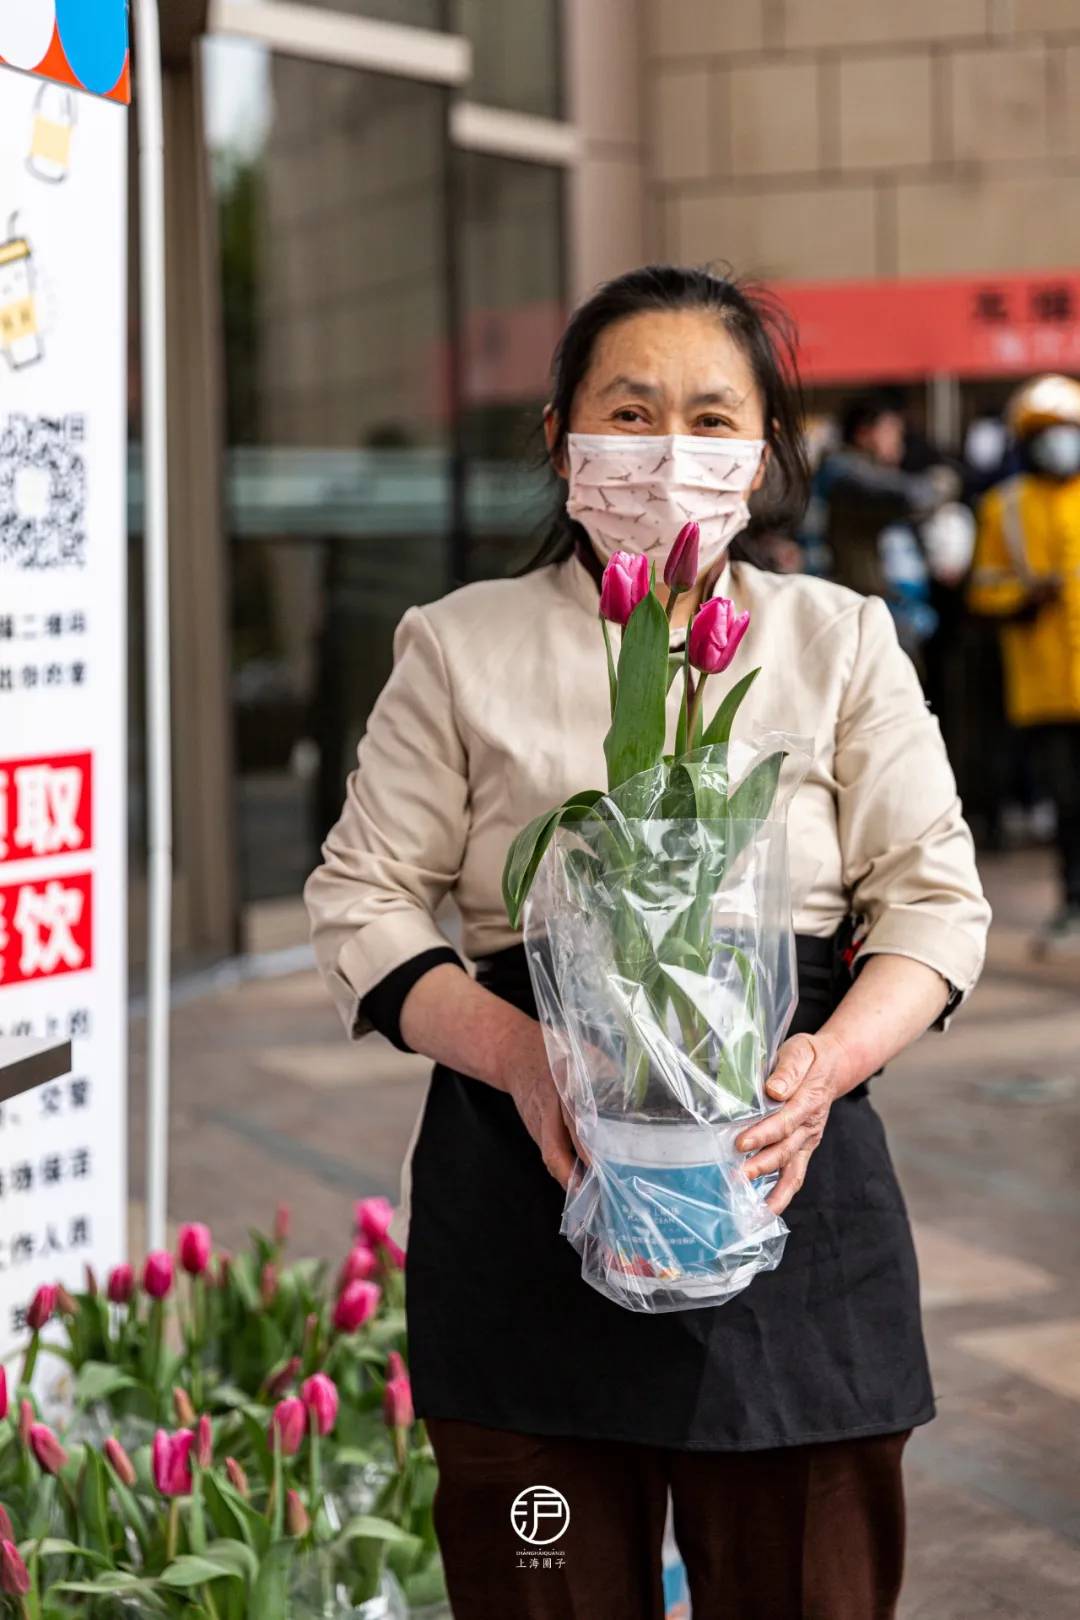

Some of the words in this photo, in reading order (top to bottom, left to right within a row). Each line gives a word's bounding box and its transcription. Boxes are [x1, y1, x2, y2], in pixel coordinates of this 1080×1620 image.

[0, 764, 84, 860] 取
[0, 880, 84, 981] 饮
[0, 1215, 88, 1270] 作人员
